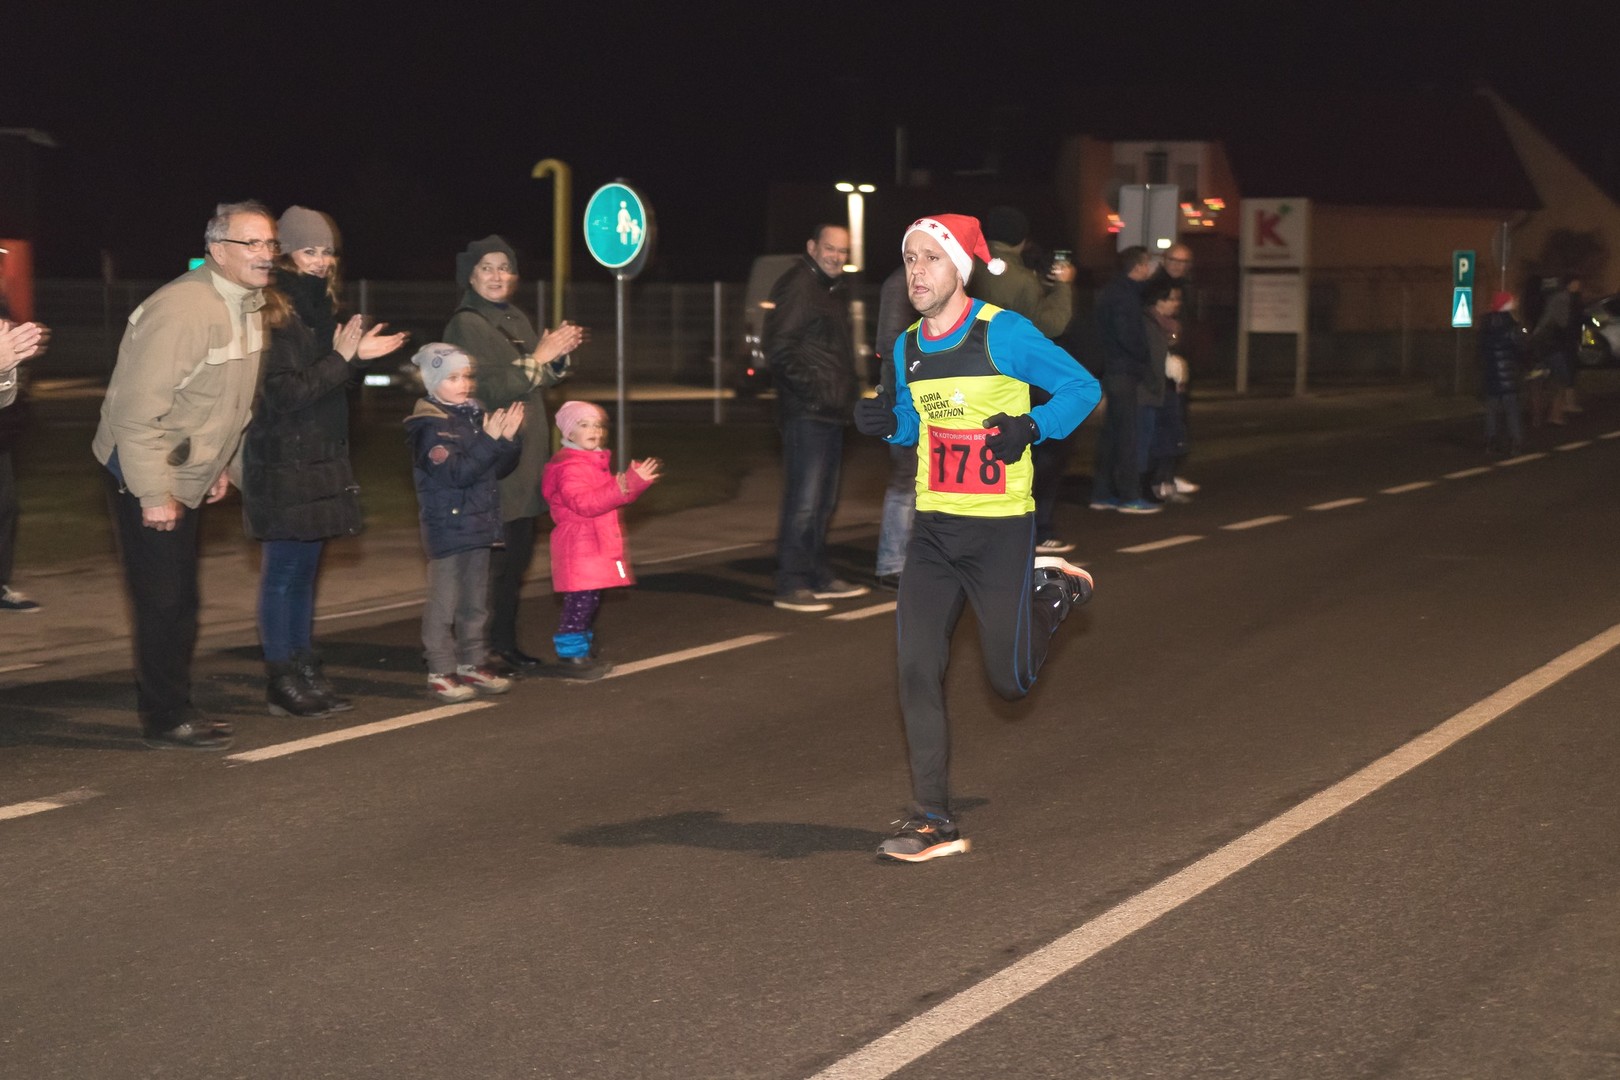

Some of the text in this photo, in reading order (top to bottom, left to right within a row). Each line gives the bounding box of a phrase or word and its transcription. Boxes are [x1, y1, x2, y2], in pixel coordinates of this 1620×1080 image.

[1254, 208, 1288, 247] K
[1459, 257, 1469, 281] P
[920, 392, 942, 404] ADRIA
[923, 400, 950, 412] ADVENT
[933, 442, 1001, 485] 178
